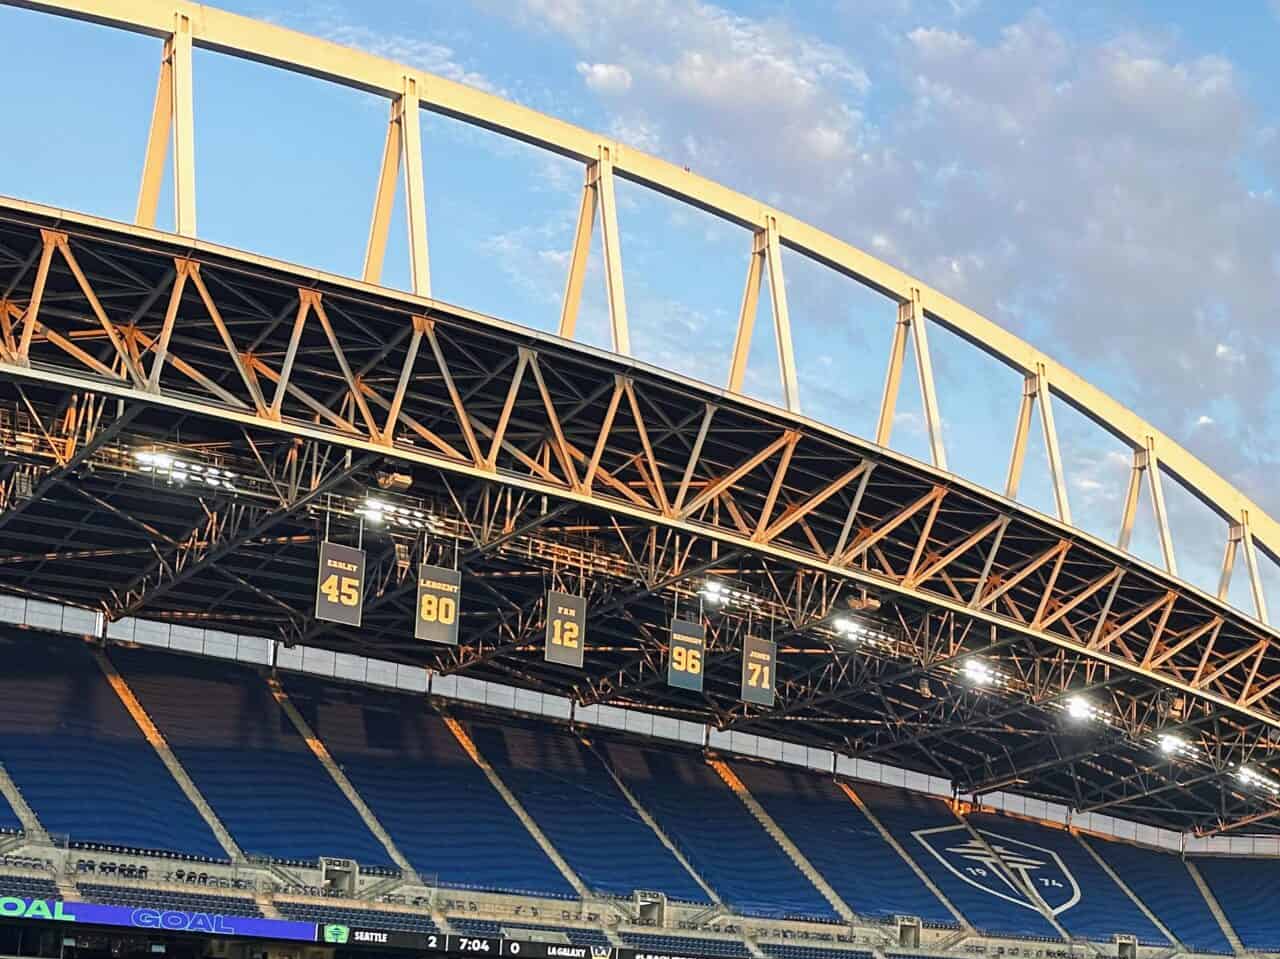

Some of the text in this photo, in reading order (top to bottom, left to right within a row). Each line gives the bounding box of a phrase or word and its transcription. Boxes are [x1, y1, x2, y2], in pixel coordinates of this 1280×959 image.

[320, 574, 359, 607] 45
[421, 594, 456, 625] 80
[551, 619, 580, 649] 12
[672, 646, 700, 675] 96
[748, 662, 770, 689] 71
[131, 908, 234, 935] GOAL
[354, 931, 388, 943] SEATTLE
[428, 936, 438, 948] 2
[459, 938, 490, 952] 7:04
[510, 942, 520, 954] 0
